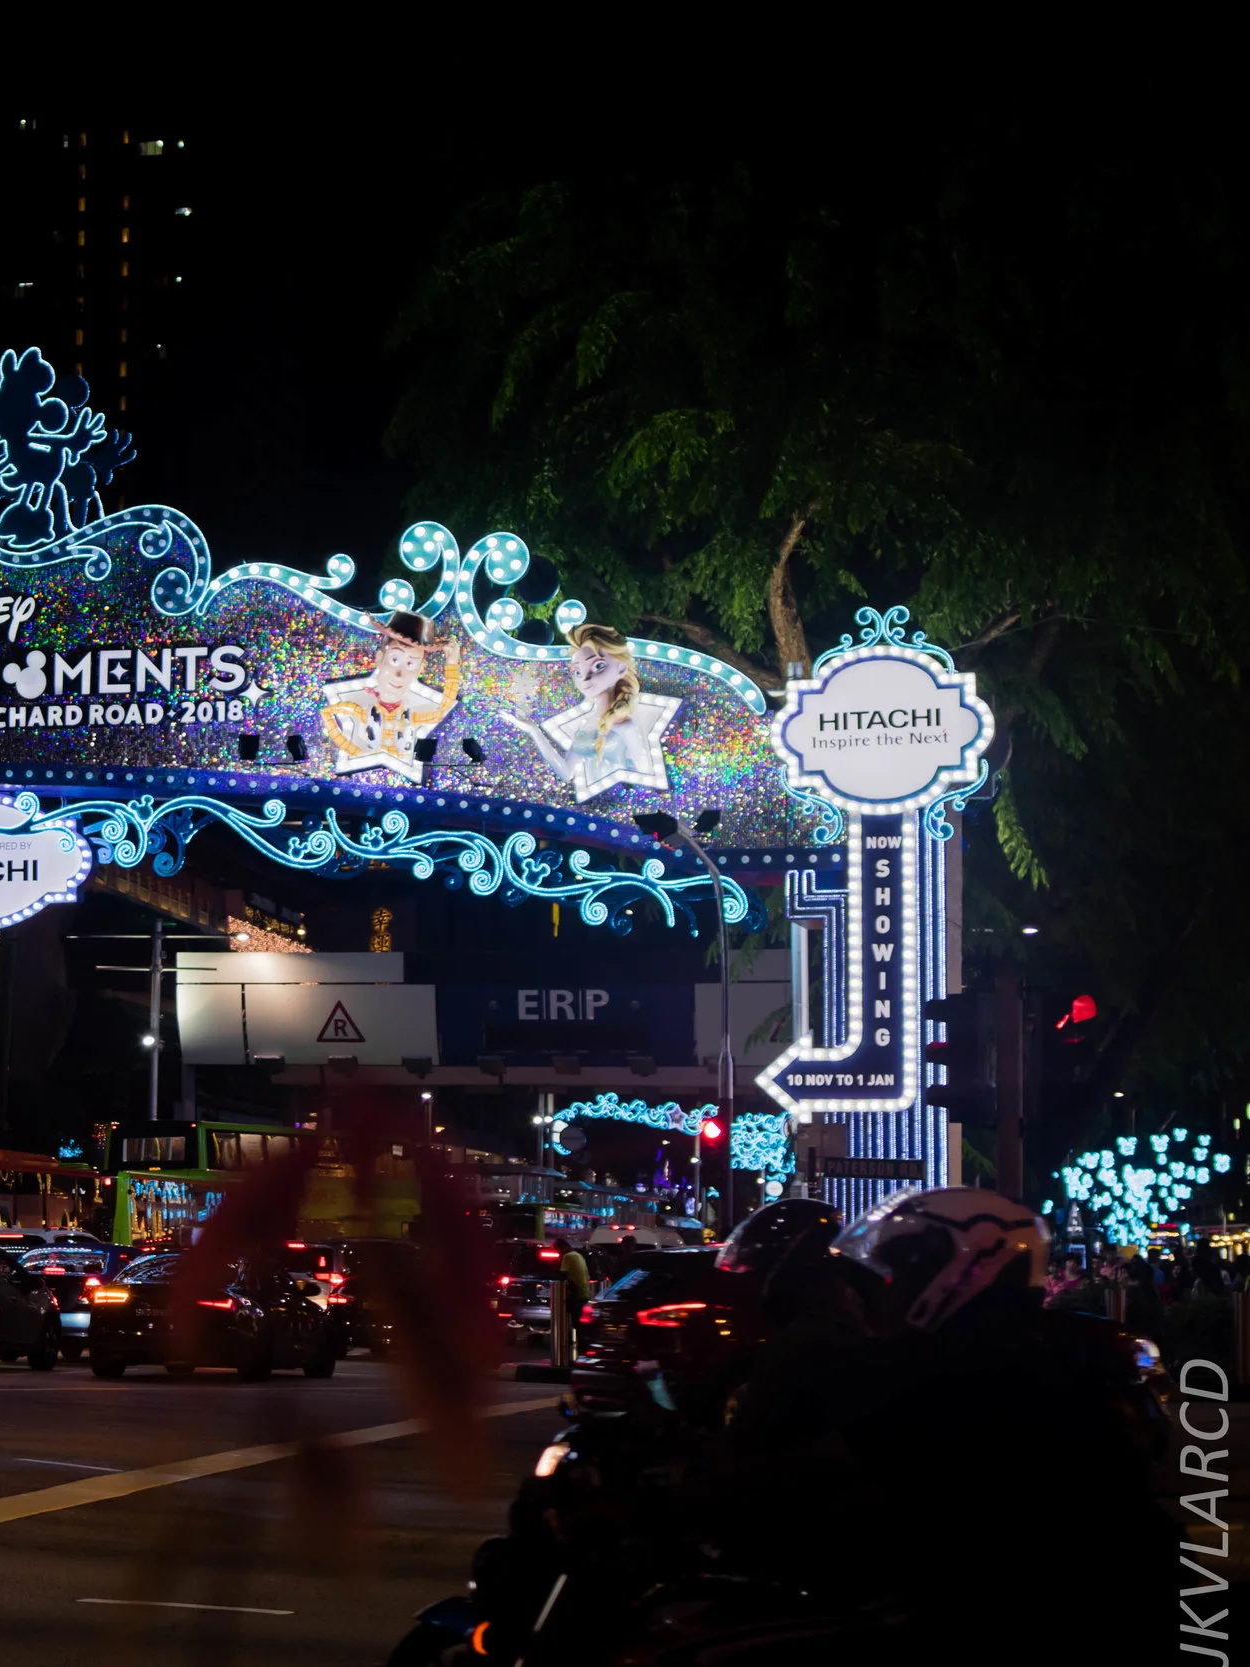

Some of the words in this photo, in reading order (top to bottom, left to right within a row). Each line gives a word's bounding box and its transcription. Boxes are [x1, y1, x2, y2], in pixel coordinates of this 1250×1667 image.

[89, 703, 164, 725] ROAD
[180, 700, 243, 723] 2018
[819, 708, 941, 731] HITACHI
[812, 735, 870, 750] Inspire
[877, 733, 903, 745] the
[909, 729, 949, 745] Next
[20, 841, 32, 850] BY
[866, 836, 902, 849] NOW
[871, 859, 894, 1047] SHOWING
[334, 1019, 348, 1036] R
[786, 1074, 803, 1086] 10
[805, 1074, 833, 1086] NOV
[835, 1074, 854, 1086] TO
[856, 1074, 864, 1086] 1
[867, 1074, 895, 1086] JAN
